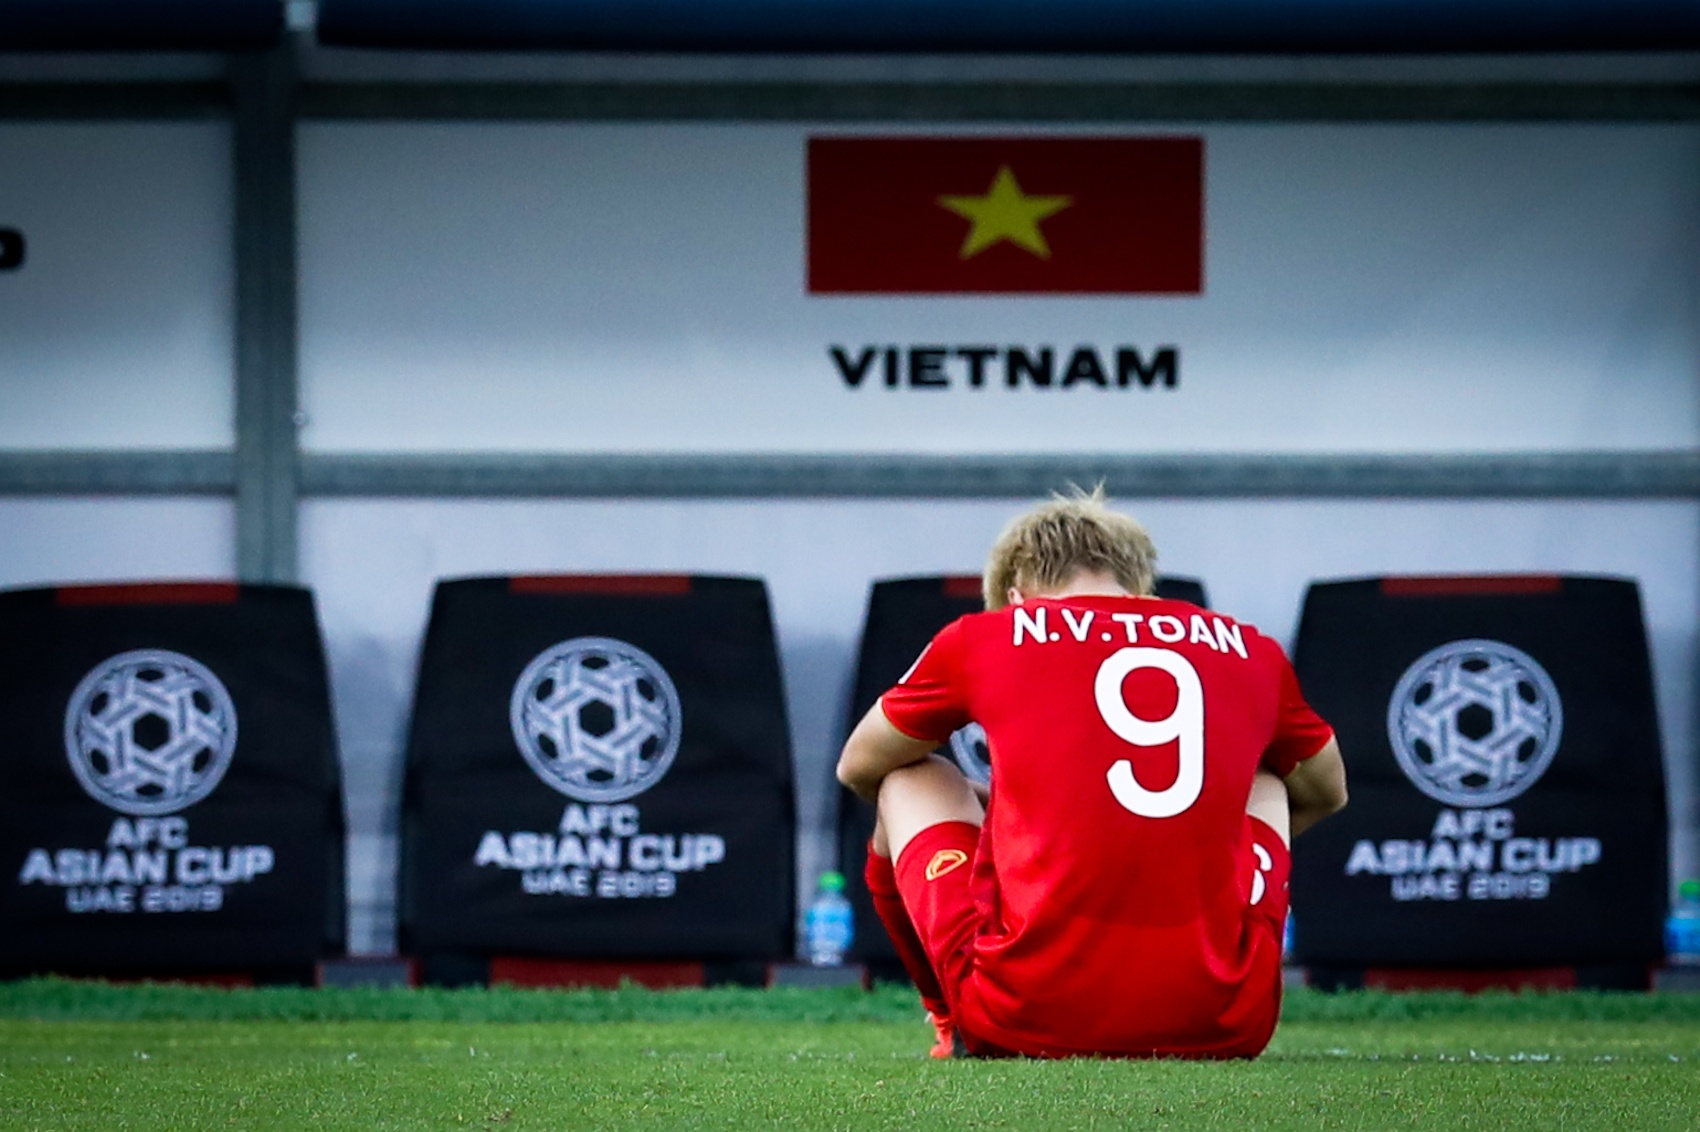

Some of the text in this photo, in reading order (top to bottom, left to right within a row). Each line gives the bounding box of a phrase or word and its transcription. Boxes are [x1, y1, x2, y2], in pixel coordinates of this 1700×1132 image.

[829, 344, 1179, 389] VIETNAM
[1094, 646, 1205, 819] 9
[106, 816, 190, 849] AFC
[558, 803, 640, 837] AFC
[1432, 807, 1516, 840] AFC
[19, 844, 275, 886] ASIAN CUP
[474, 830, 727, 872] ASIAN CUP
[1345, 836, 1603, 876] ASIAN CUP
[65, 885, 136, 913] UAE
[521, 869, 677, 898] UAE 2019
[1391, 873, 1462, 901] UAE
